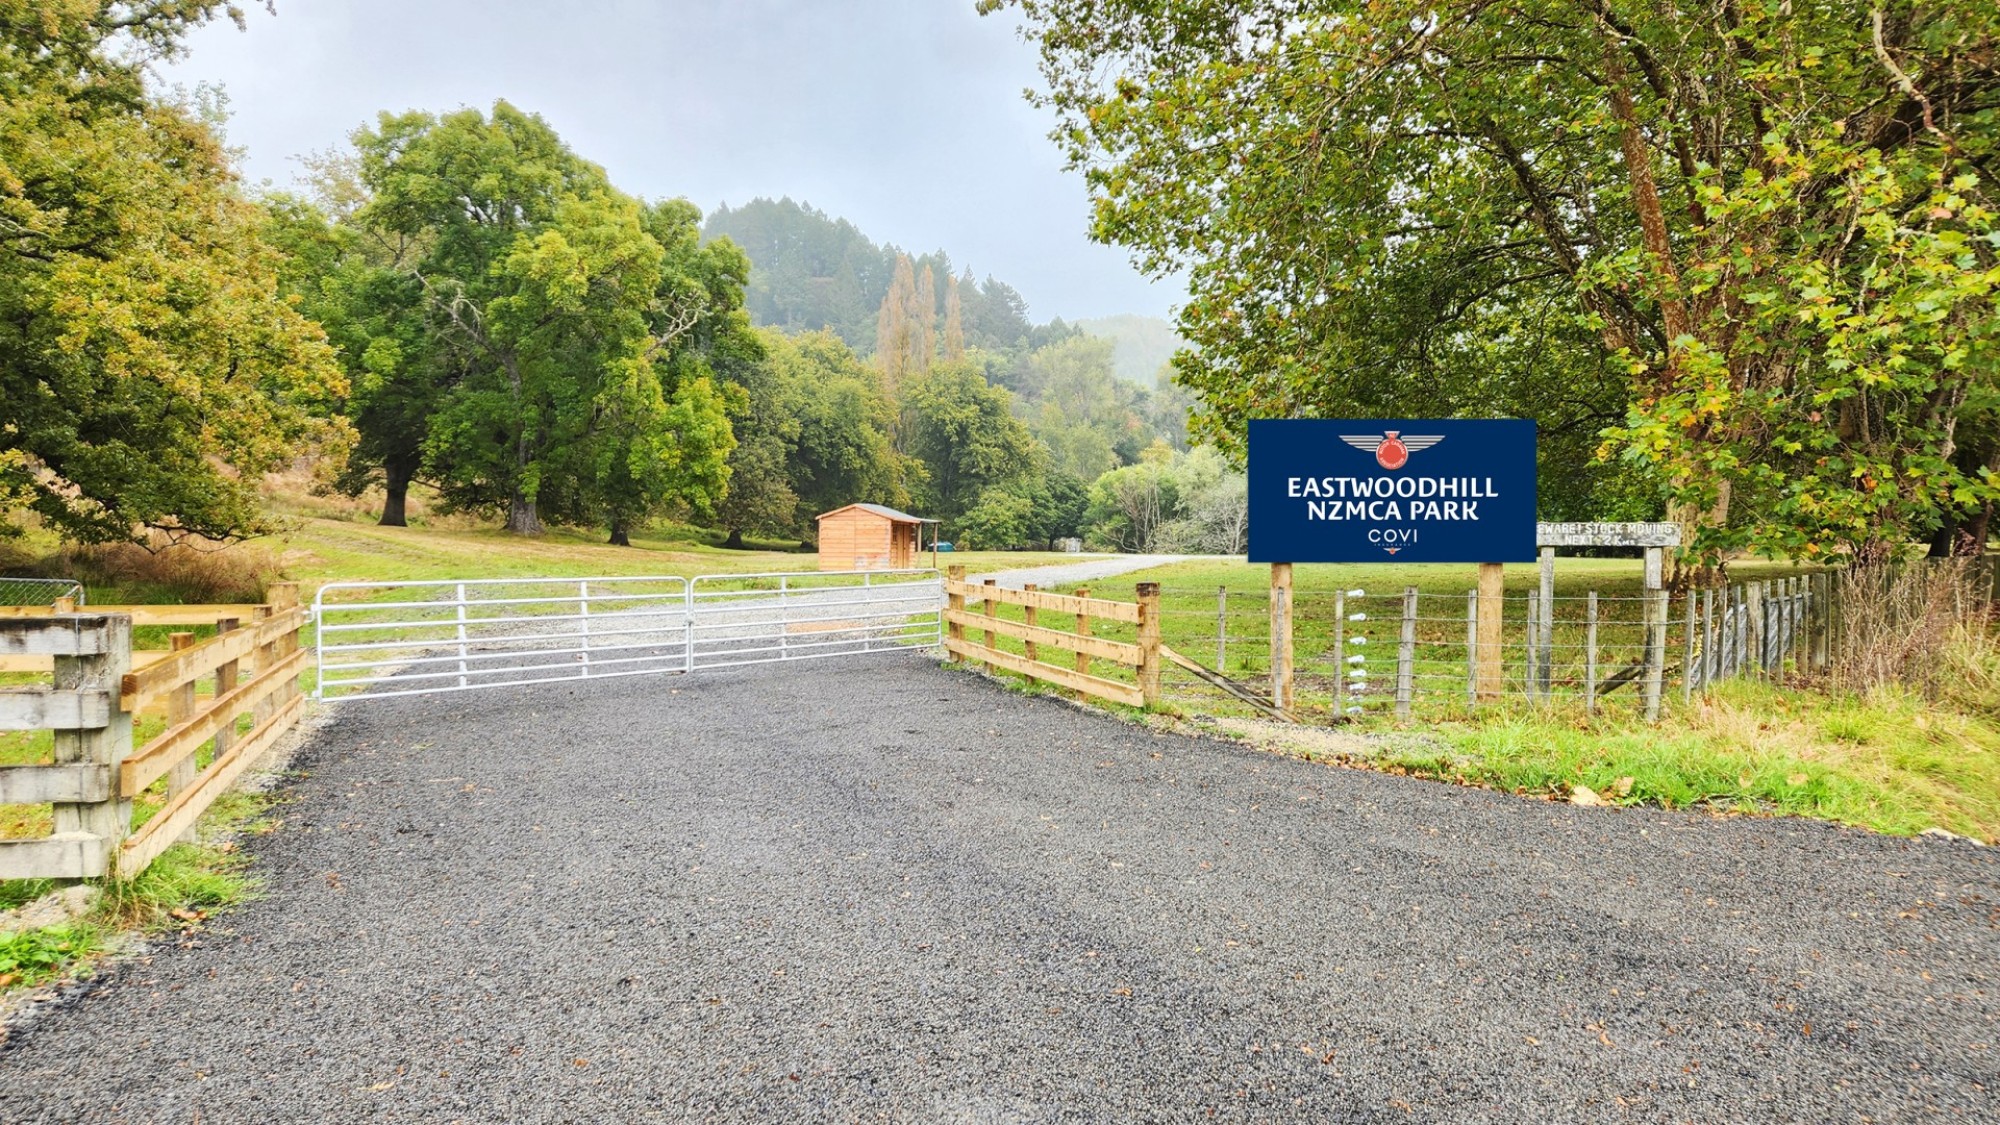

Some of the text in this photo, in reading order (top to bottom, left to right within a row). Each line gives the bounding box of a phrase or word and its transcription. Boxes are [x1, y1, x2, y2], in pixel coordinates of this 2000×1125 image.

[1287, 477, 1499, 498] EASTWOODHILL
[1307, 501, 1479, 521] NZMCA PARK
[1368, 529, 1417, 543] COVI
[1536, 524, 1673, 534] EWARE! STOCK MOVING
[1565, 535, 1594, 545] NEXT
[1602, 535, 1611, 545] 2
